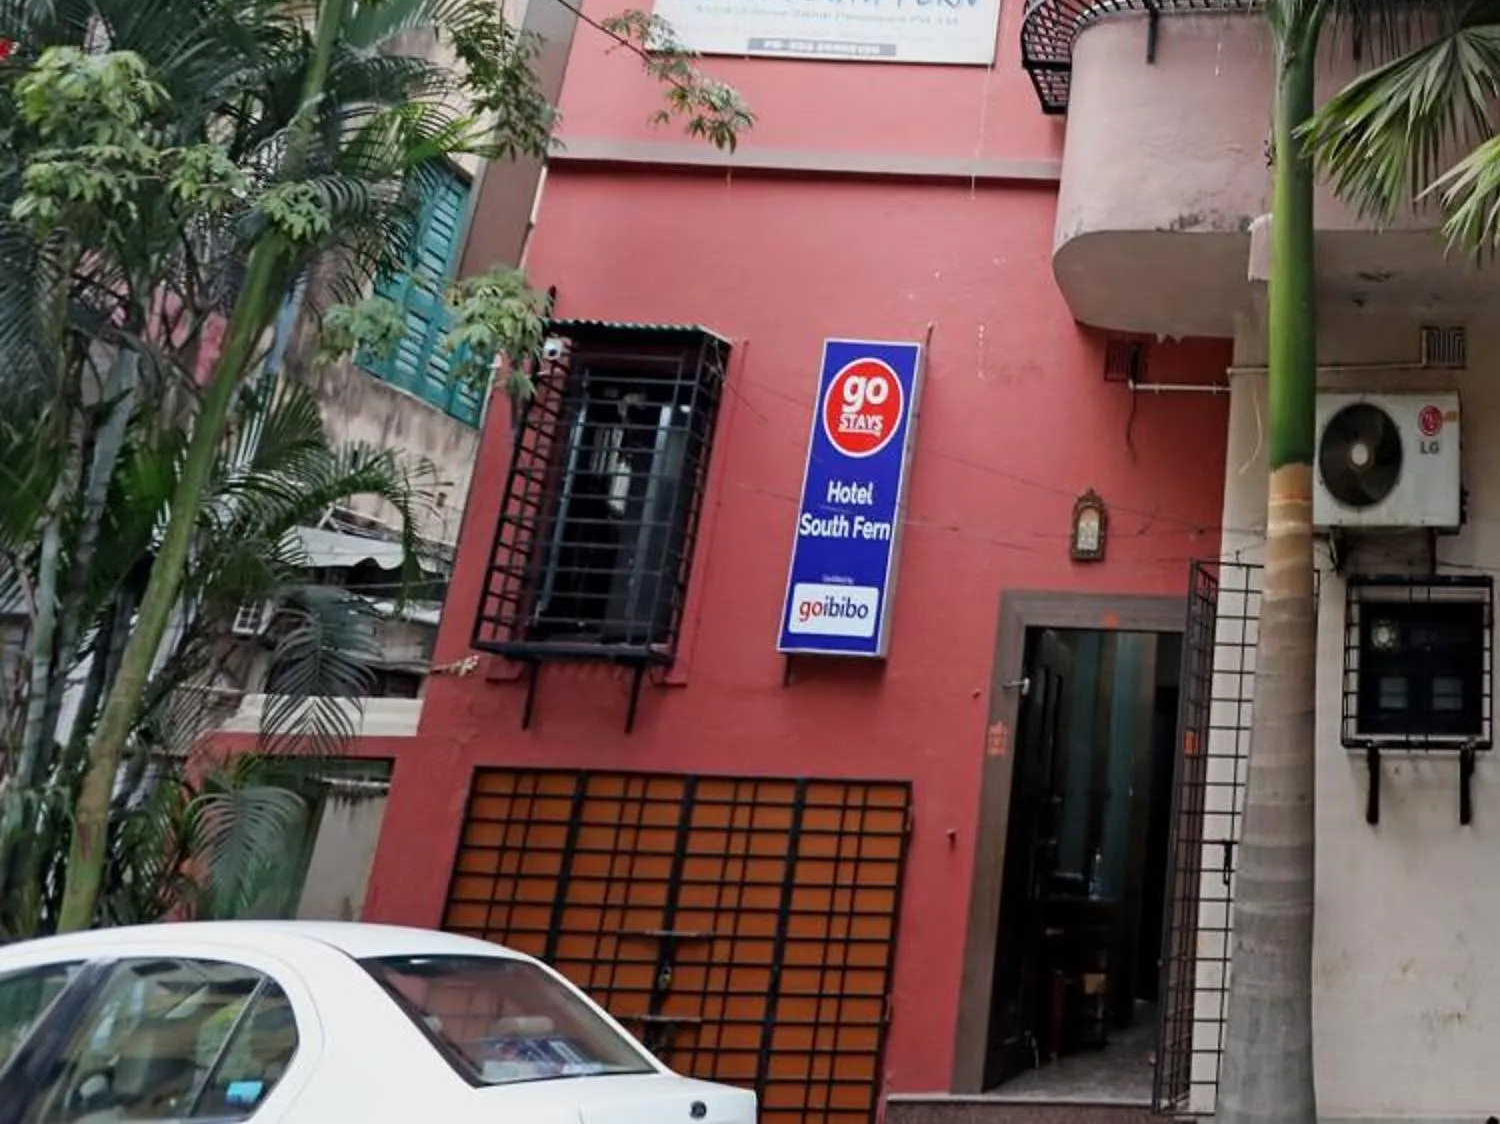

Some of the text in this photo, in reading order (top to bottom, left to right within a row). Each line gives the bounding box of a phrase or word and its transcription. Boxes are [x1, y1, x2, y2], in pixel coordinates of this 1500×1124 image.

[842, 376, 889, 413] go
[839, 412, 884, 433] STAYS
[1420, 440, 1440, 455] LG
[827, 480, 873, 506] Hotel
[800, 513, 891, 541] South Fern
[799, 596, 869, 622] goibibo
